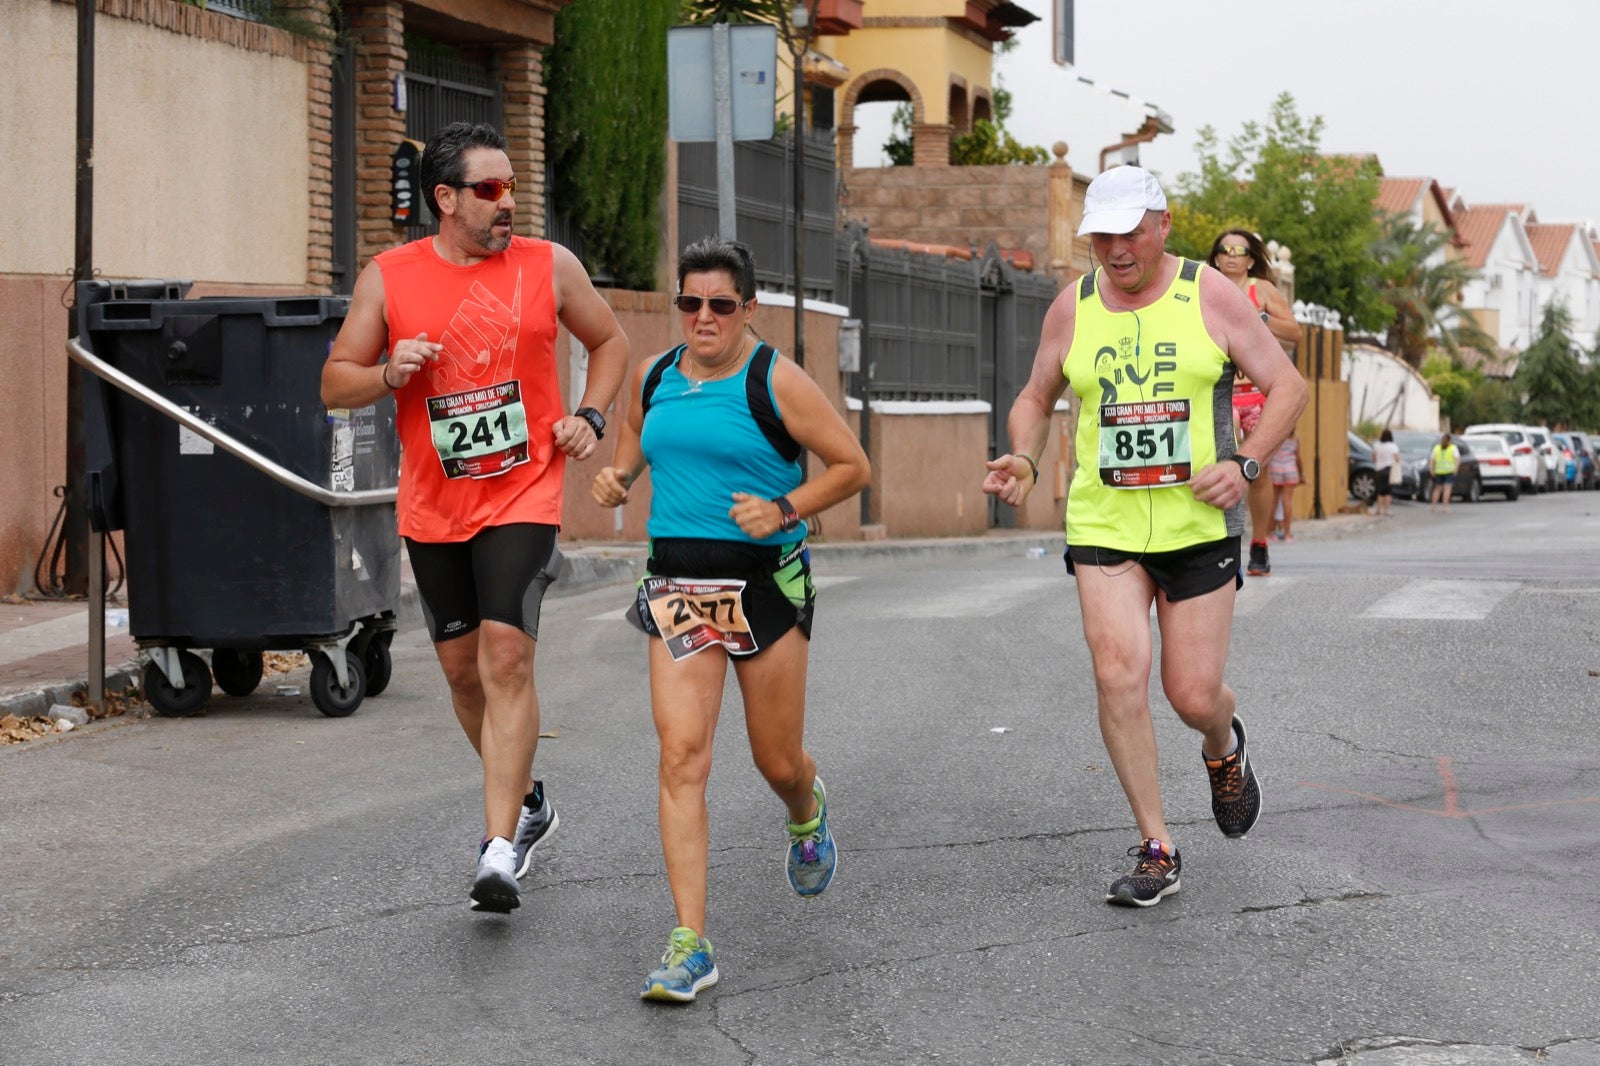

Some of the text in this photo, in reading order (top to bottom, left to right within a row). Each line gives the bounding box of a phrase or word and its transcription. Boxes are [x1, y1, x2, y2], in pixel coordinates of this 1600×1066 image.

[446, 395, 464, 409] GRAN
[464, 391, 488, 404] PREMIO
[487, 388, 496, 399] DE
[1116, 404, 1132, 416] GRAN
[1157, 402, 1165, 413] DE
[1166, 401, 1185, 412] FONDO
[448, 411, 511, 452] 241
[1116, 427, 1174, 460] 851
[667, 598, 736, 626] 2077
